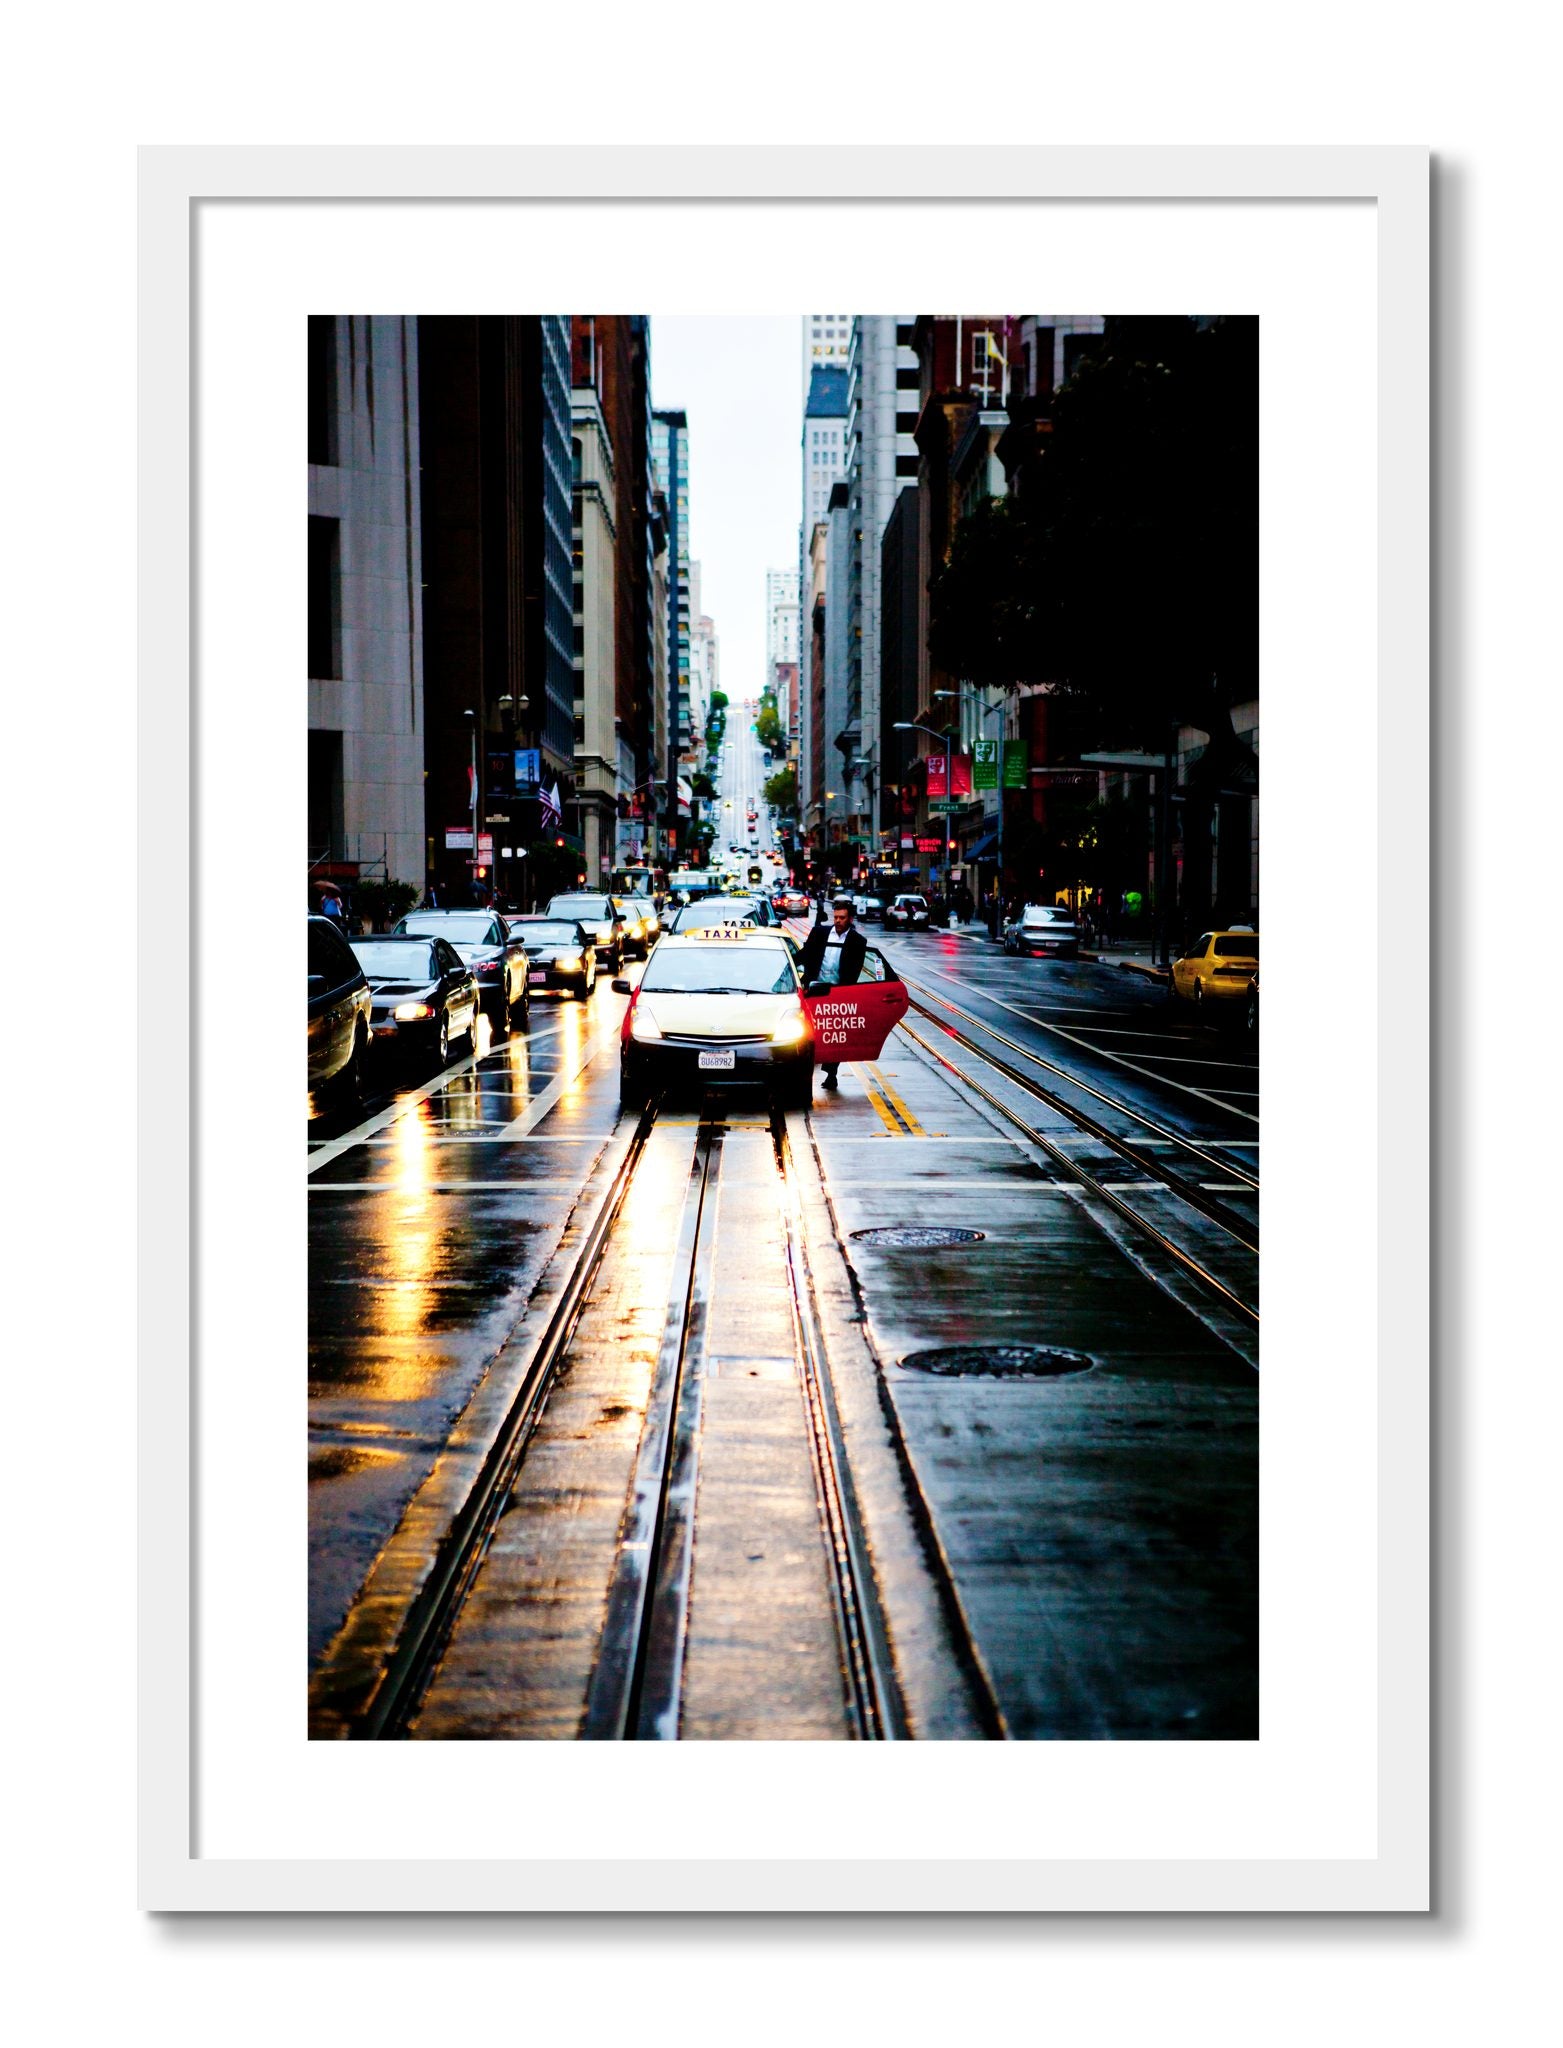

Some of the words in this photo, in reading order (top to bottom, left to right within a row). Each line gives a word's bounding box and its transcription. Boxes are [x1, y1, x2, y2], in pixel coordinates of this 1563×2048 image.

[704, 930, 738, 938] TAXI
[815, 1003, 857, 1015] ARROW
[822, 1031, 847, 1044] CAB
